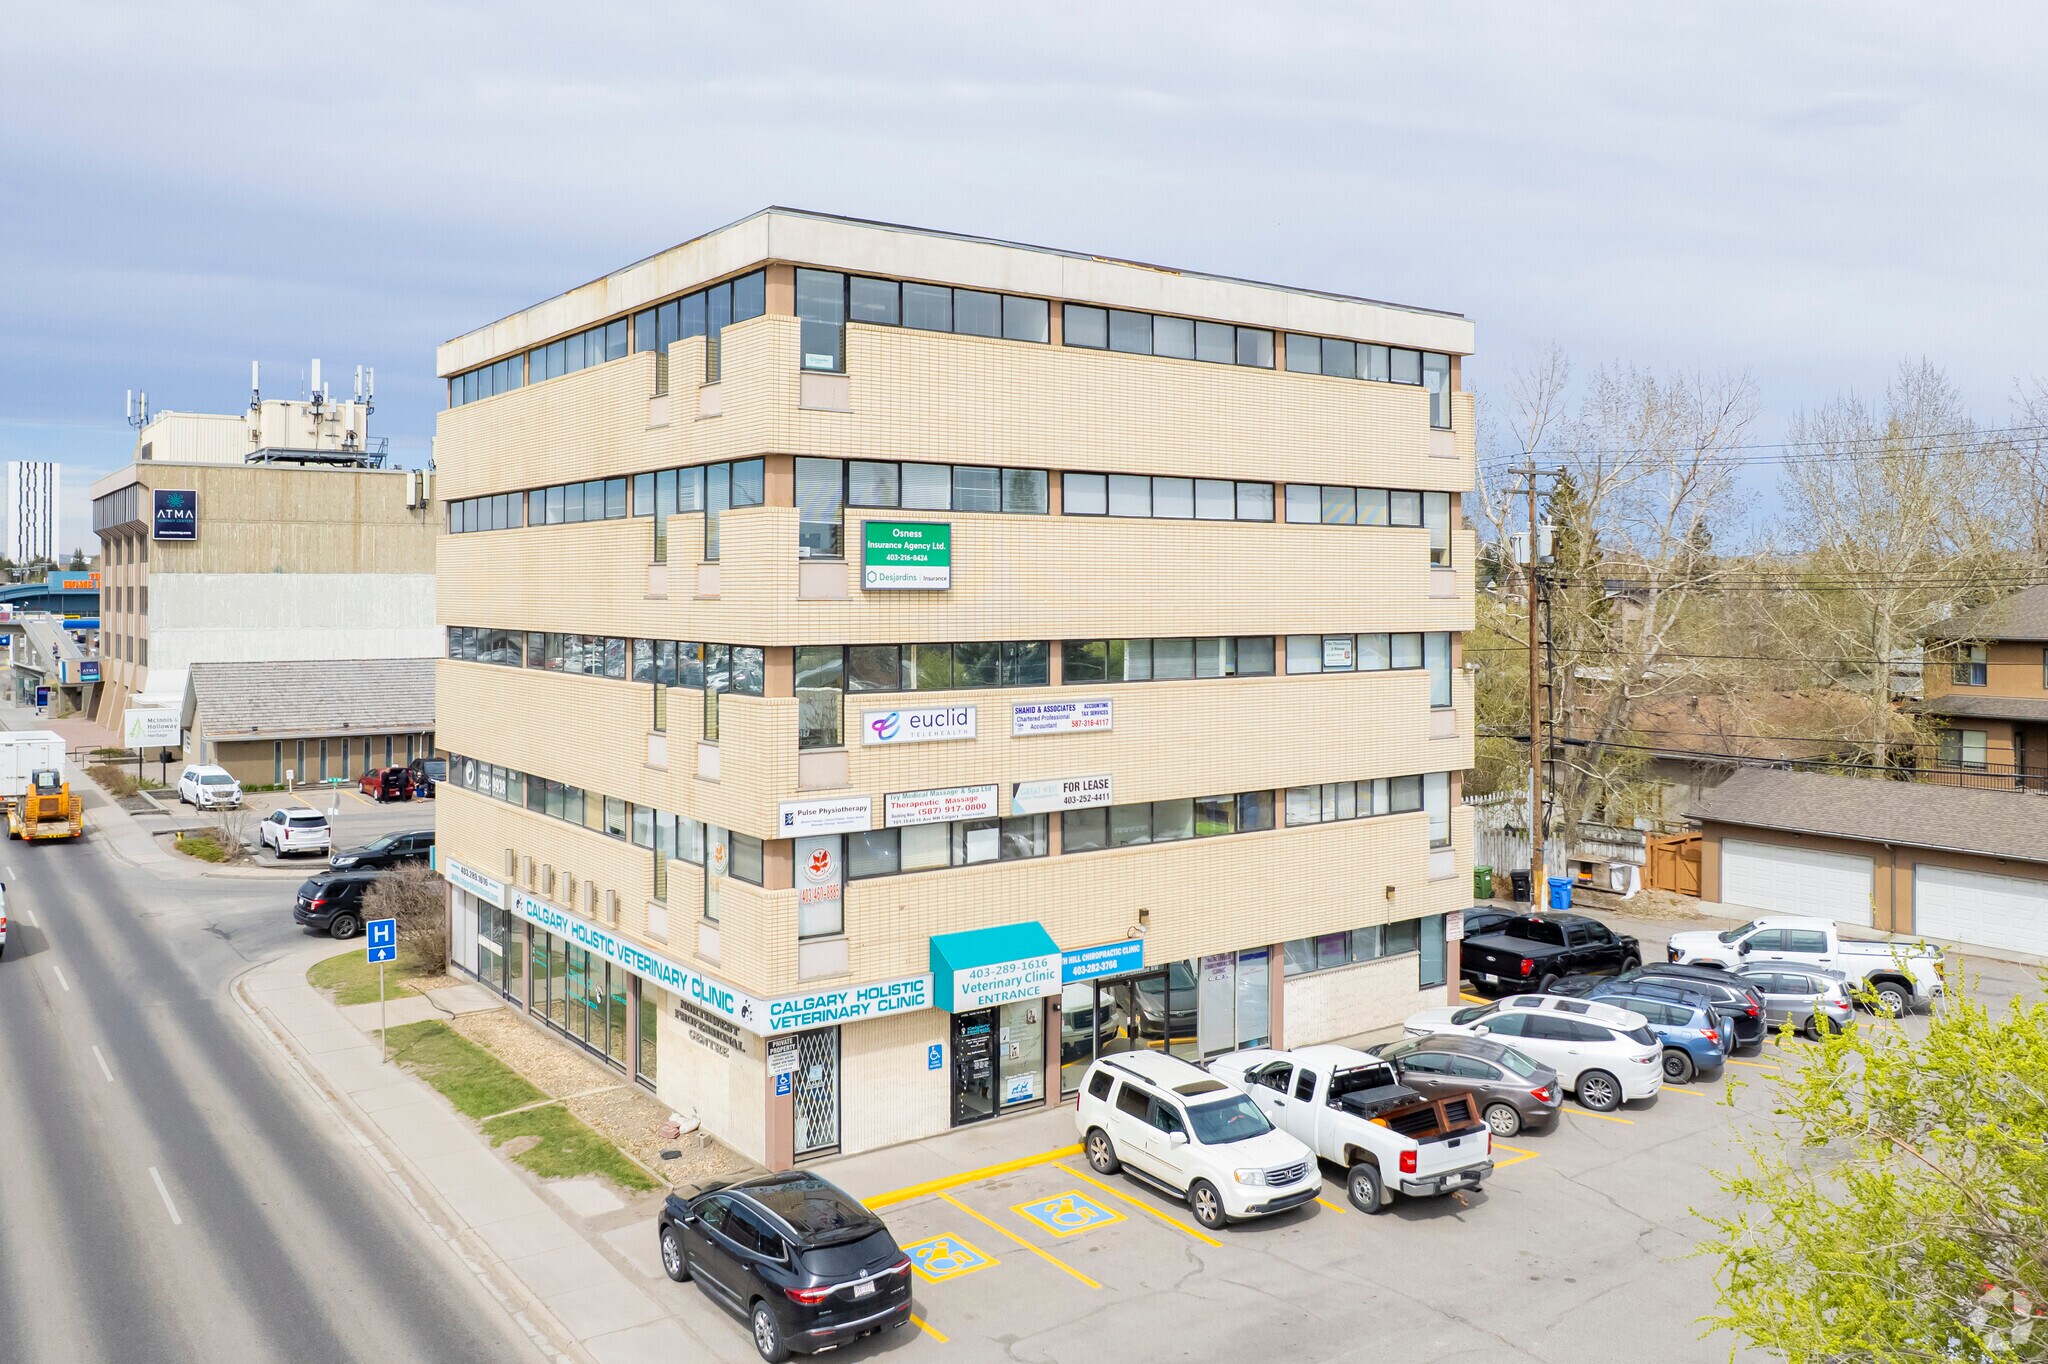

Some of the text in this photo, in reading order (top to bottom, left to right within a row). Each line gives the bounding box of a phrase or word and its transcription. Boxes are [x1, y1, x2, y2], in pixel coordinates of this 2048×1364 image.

[157, 509, 194, 519] ATMA
[892, 528, 923, 538] Osness
[867, 541, 946, 551] Insurance Agency Ltd.
[886, 554, 928, 562] 403-216-8424
[63, 580, 94, 589] HOME
[879, 573, 917, 583] Desjardins
[1014, 706, 1036, 715] SHAHID
[1043, 704, 1076, 713] ASSOCIATES
[910, 707, 968, 729] euclid
[1016, 715, 1041, 723] Chartered
[1041, 713, 1071, 721] Professional
[1030, 722, 1058, 730] Accountant
[1071, 718, 1109, 728] 587-316-4117
[911, 730, 968, 738] TELEHEALTH
[1063, 778, 1109, 793] FOR LEASE
[902, 792, 929, 800] Medical
[930, 788, 959, 797] Massage
[1063, 792, 1110, 805] 403-252-4411
[891, 795, 979, 809] Therapeutic Massage
[918, 802, 987, 816] (587) 917-0800
[819, 805, 868, 815] Physiotherapy
[374, 924, 389, 943] H
[527, 900, 568, 934] CALGARY
[571, 921, 615, 957] HOLISTIC
[617, 942, 688, 991] VETERINARY
[691, 977, 734, 1015] CLINIC
[1068, 955, 1082, 964] HILL
[1081, 949, 1122, 962] CHIROPRACTIC
[1122, 944, 1141, 955] CLINIC
[969, 957, 1048, 980] 403-289-1616
[1072, 959, 1118, 976] 403-282-3766
[961, 968, 1055, 995] Veterinary Clinic
[770, 980, 924, 1016] CALGARY HOLISTIC
[978, 985, 1041, 1006] ENTRANCE
[680, 1000, 741, 1037] NORTHWEST
[769, 993, 925, 1030] VETERINARY CLINIC
[674, 1008, 746, 1053] PROFESSIONAL
[688, 1029, 730, 1058] CENTRE
[769, 1044, 796, 1055] PROPERTY
[772, 1038, 793, 1048] PRIVATE
